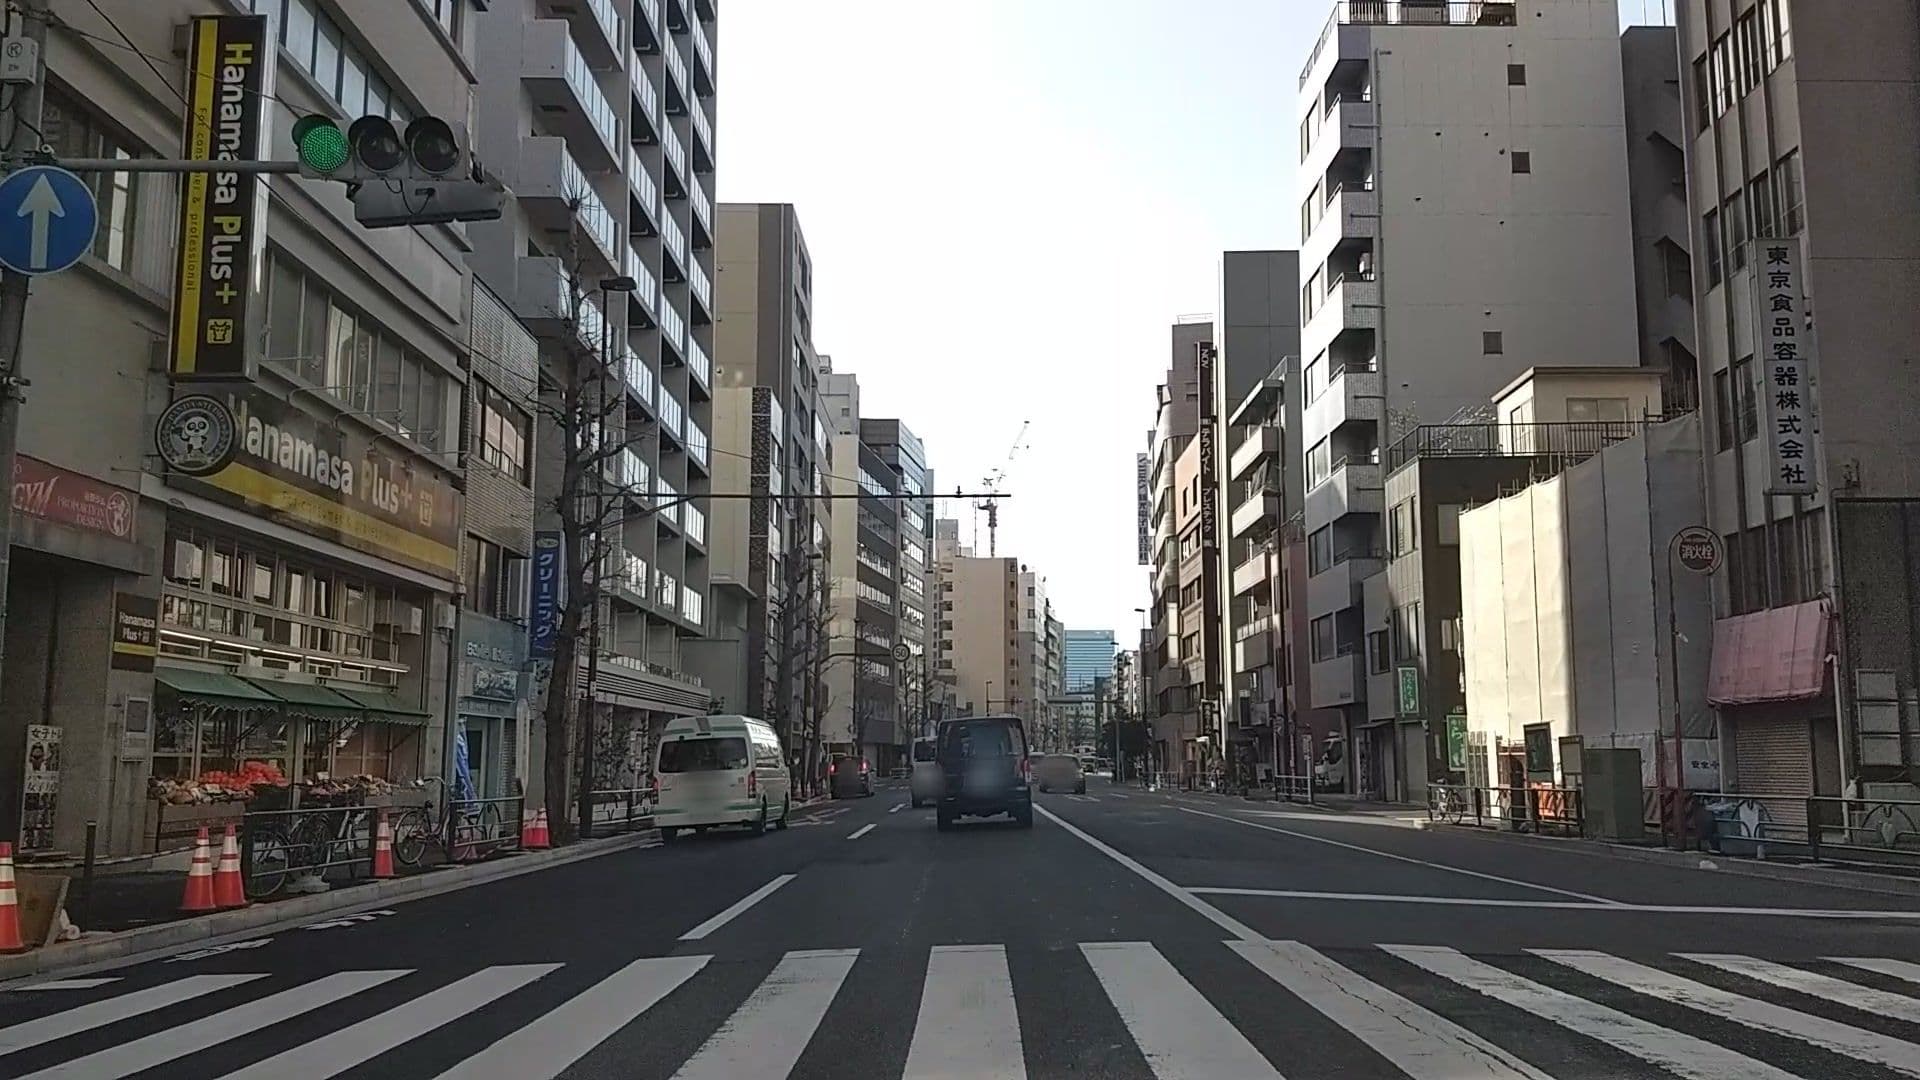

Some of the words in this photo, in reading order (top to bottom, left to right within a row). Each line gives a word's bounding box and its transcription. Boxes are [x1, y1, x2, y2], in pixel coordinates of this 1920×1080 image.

[210, 215, 243, 305] Plus+
[1766, 246, 1807, 484] 東京食品容器株式会社
[537, 553, 554, 638] クリーニング
[1681, 544, 1713, 560] 消火栓
